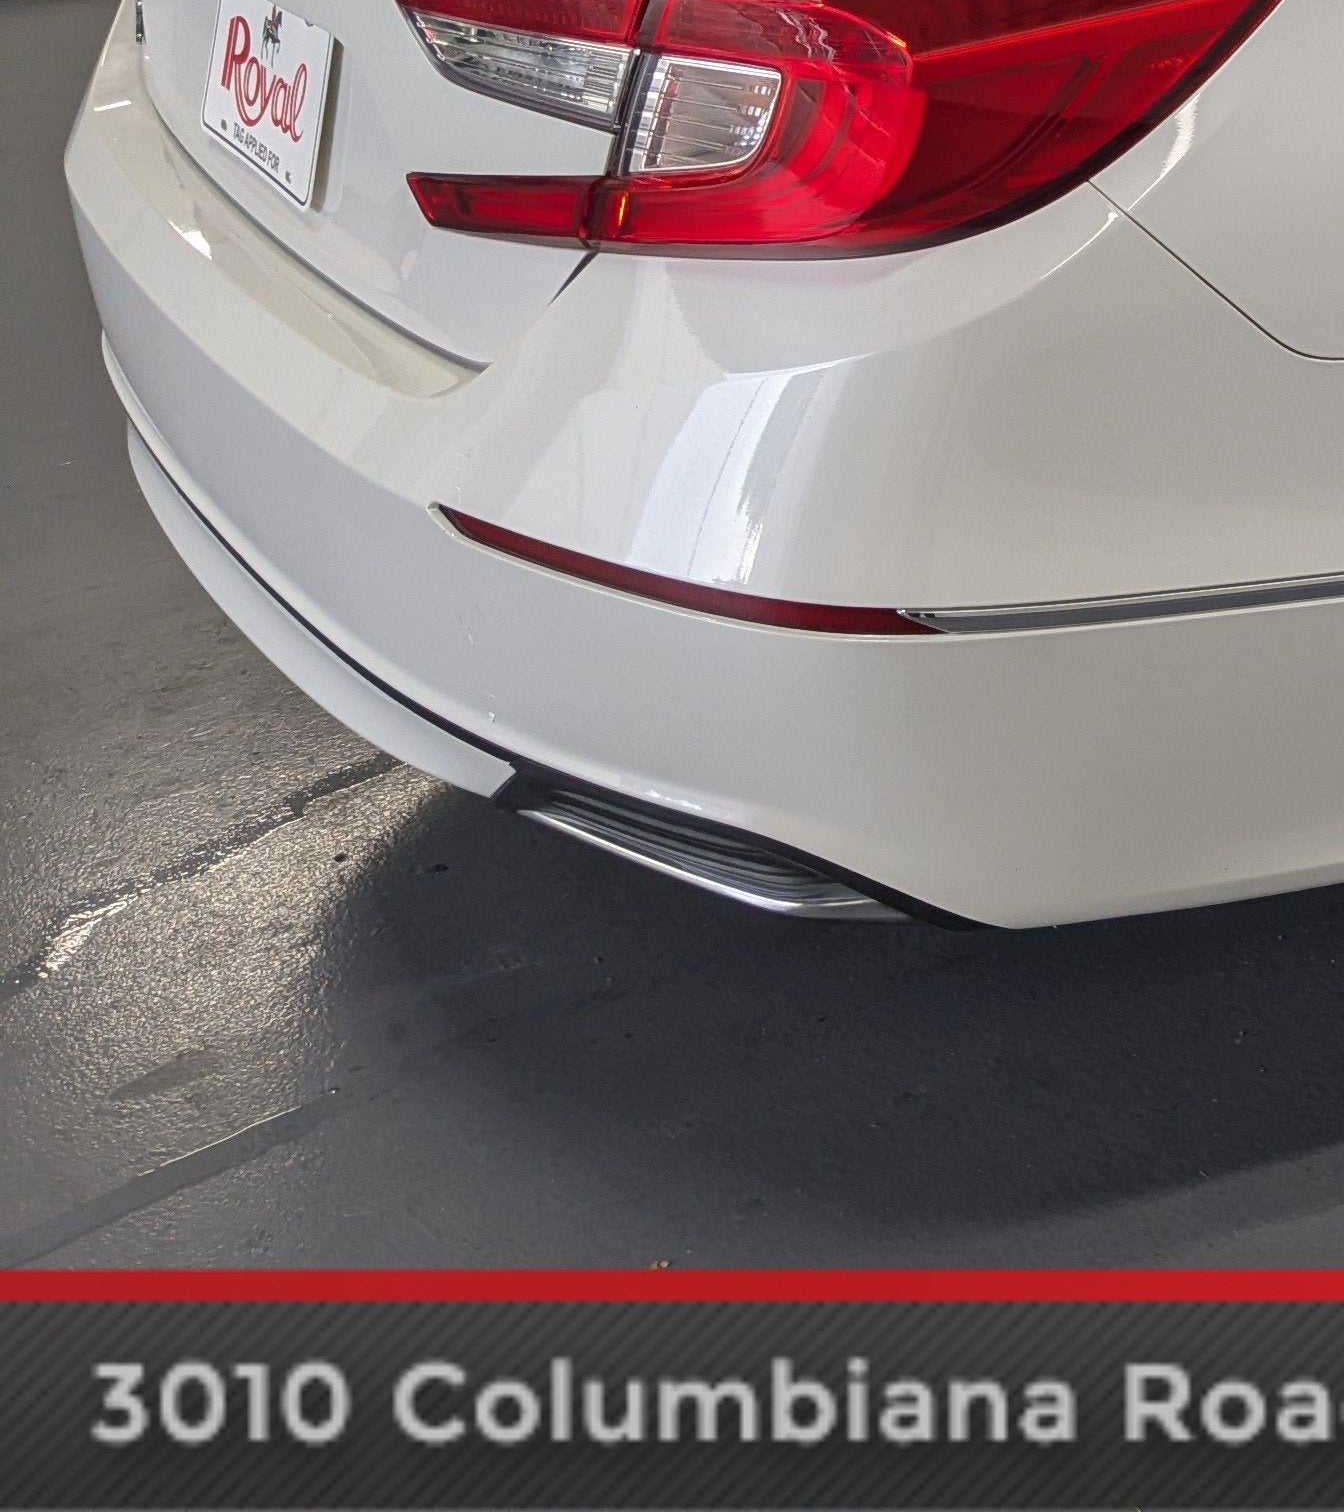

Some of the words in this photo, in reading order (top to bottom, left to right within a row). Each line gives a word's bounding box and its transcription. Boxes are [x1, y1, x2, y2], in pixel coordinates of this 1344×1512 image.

[221, 15, 308, 143] Royal
[233, 121, 244, 143] TAG
[244, 131, 267, 162] APPLIED
[267, 149, 279, 173] FOR
